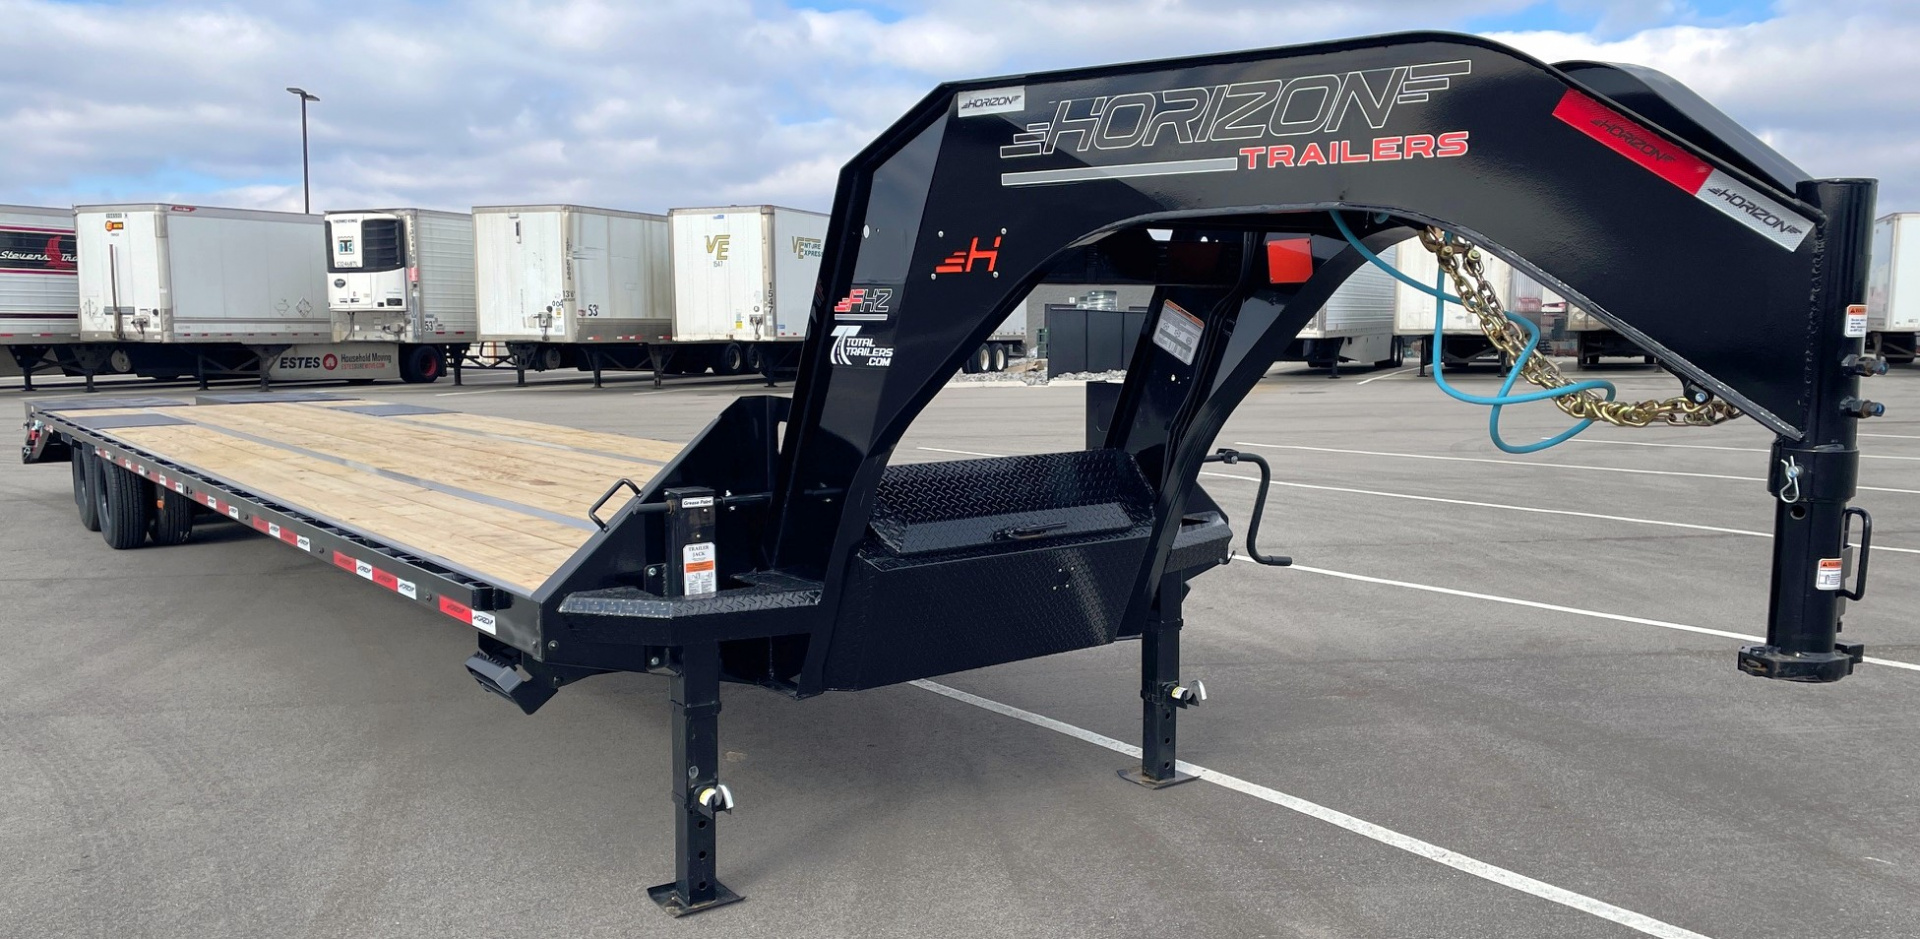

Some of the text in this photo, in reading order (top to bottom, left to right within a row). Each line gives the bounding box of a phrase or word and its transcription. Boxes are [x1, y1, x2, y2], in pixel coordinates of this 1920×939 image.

[965, 96, 1015, 109] HORIZON
[1042, 66, 1410, 156] HORIZON
[1597, 118, 1670, 162] HORIZON
[1239, 131, 1470, 170] TRAILERS
[1714, 188, 1794, 234] HORIZON
[704, 234, 730, 260] VE
[0, 250, 52, 261] Stevens
[846, 338, 876, 347] TOTAL
[341, 352, 392, 364] Household Moving
[846, 347, 894, 357] TRAILERS
[279, 356, 321, 369] ESTES
[866, 357, 891, 367] .COM
